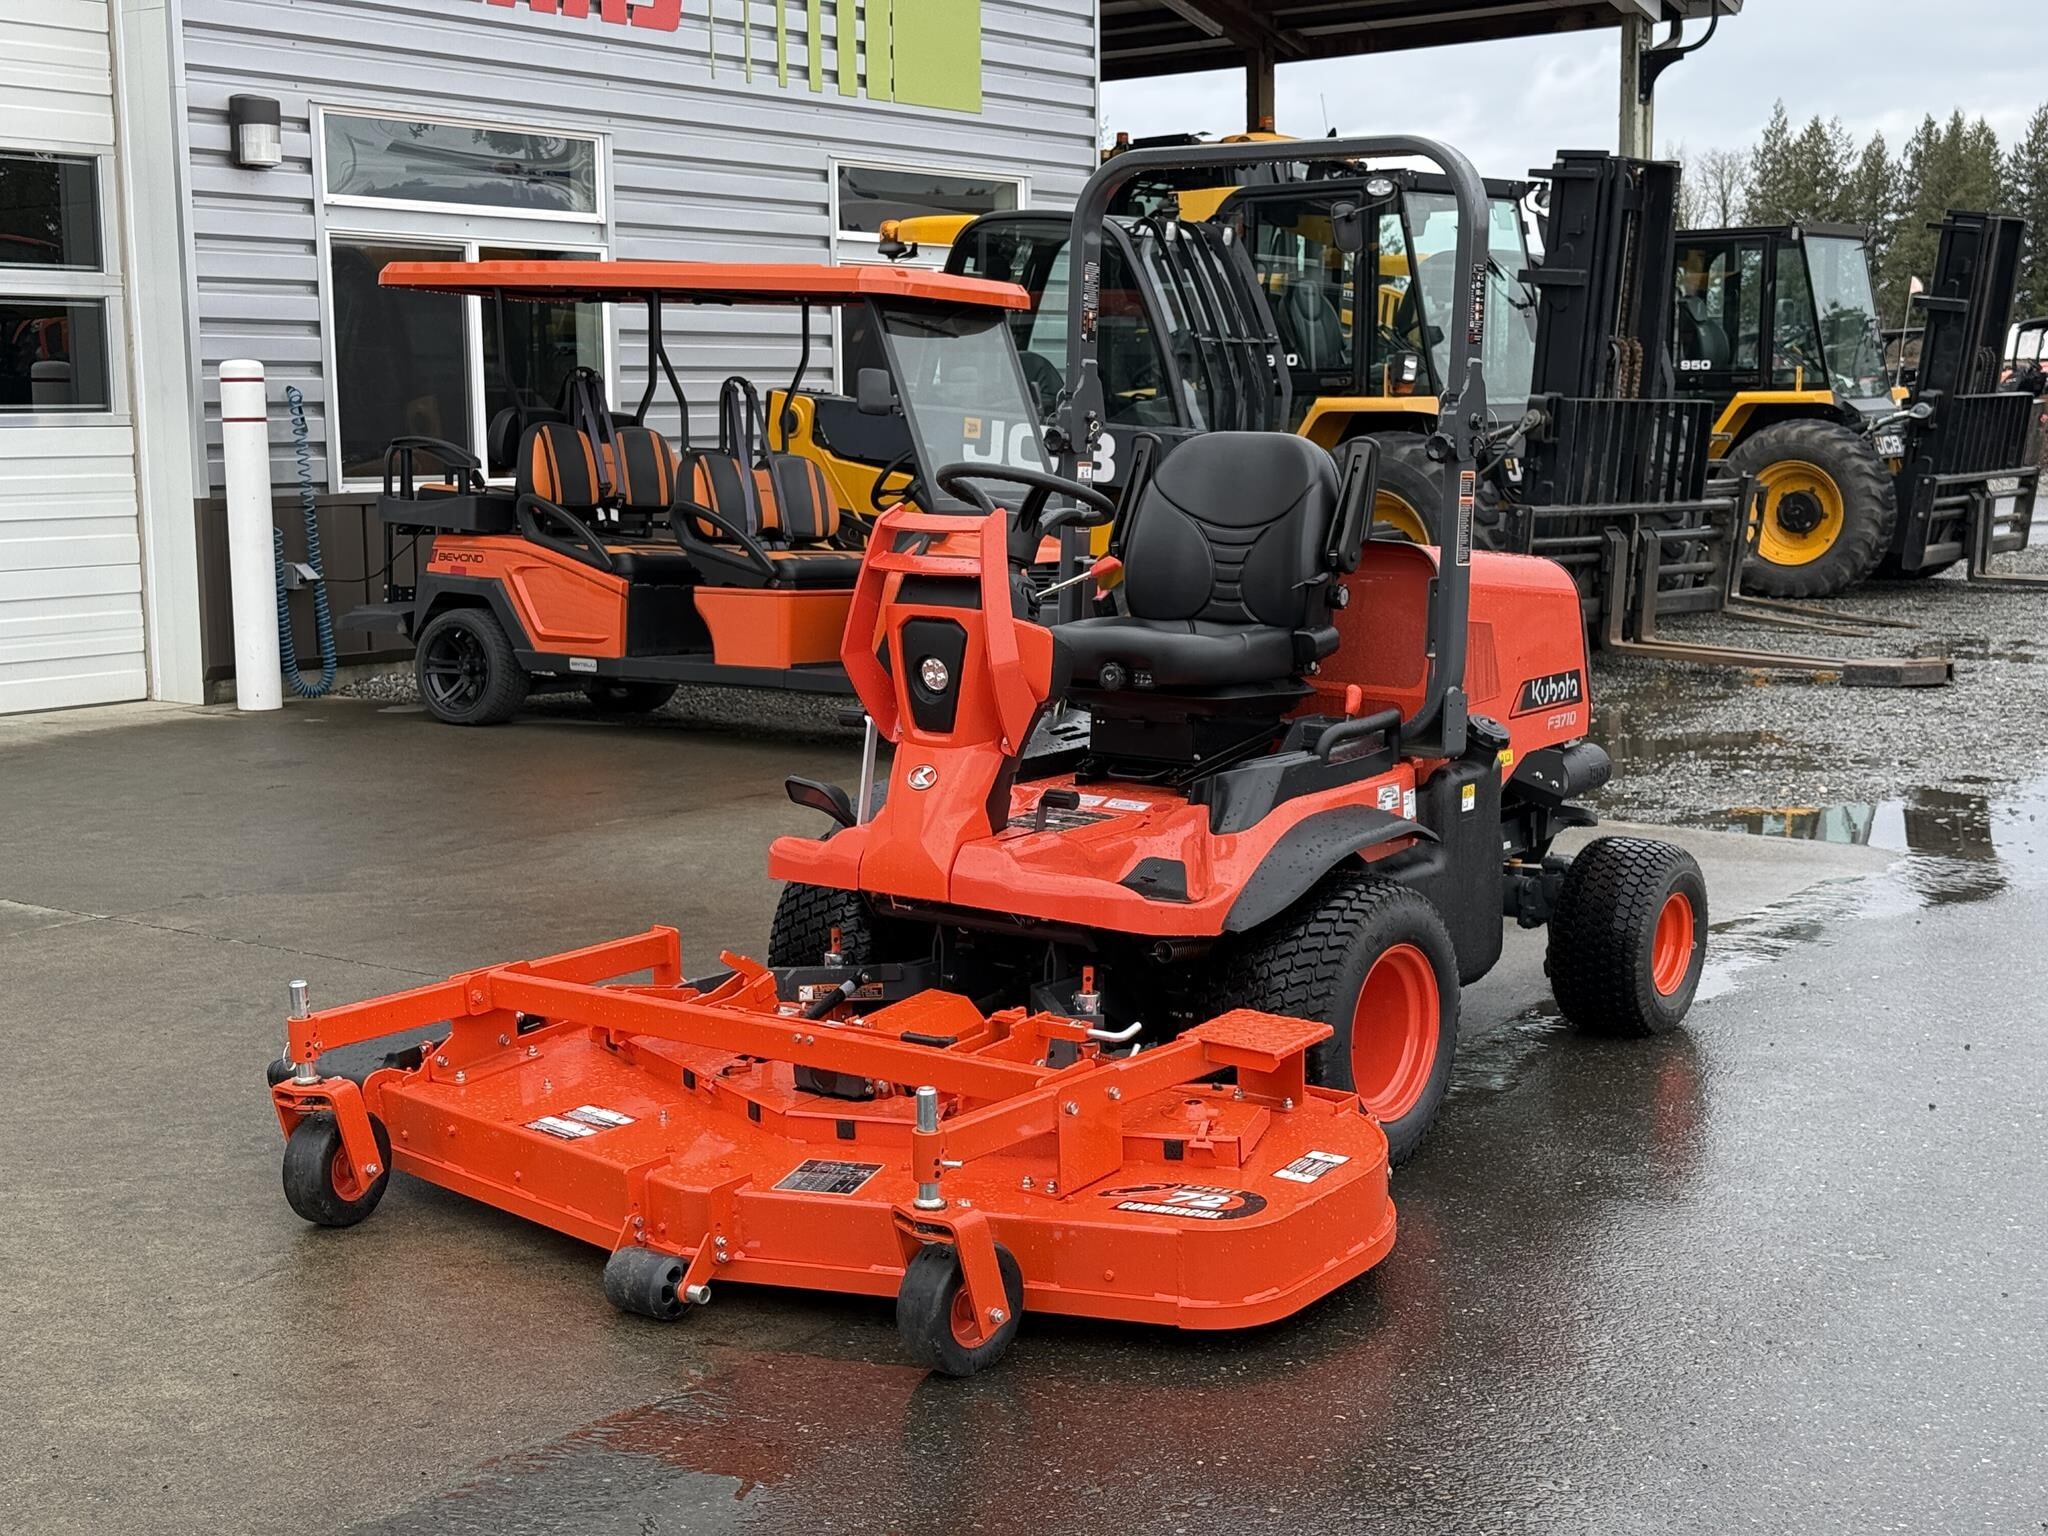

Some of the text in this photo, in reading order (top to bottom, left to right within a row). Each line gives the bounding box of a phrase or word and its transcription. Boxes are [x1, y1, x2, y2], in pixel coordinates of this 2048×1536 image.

[1680, 359, 1712, 371] 950
[438, 552, 484, 564] BEYOND
[1531, 672, 1578, 705] Kubota
[1547, 710, 1577, 731] F3710
[1163, 1190, 1232, 1209] 72
[1116, 1201, 1225, 1219] COMMERCIAL
